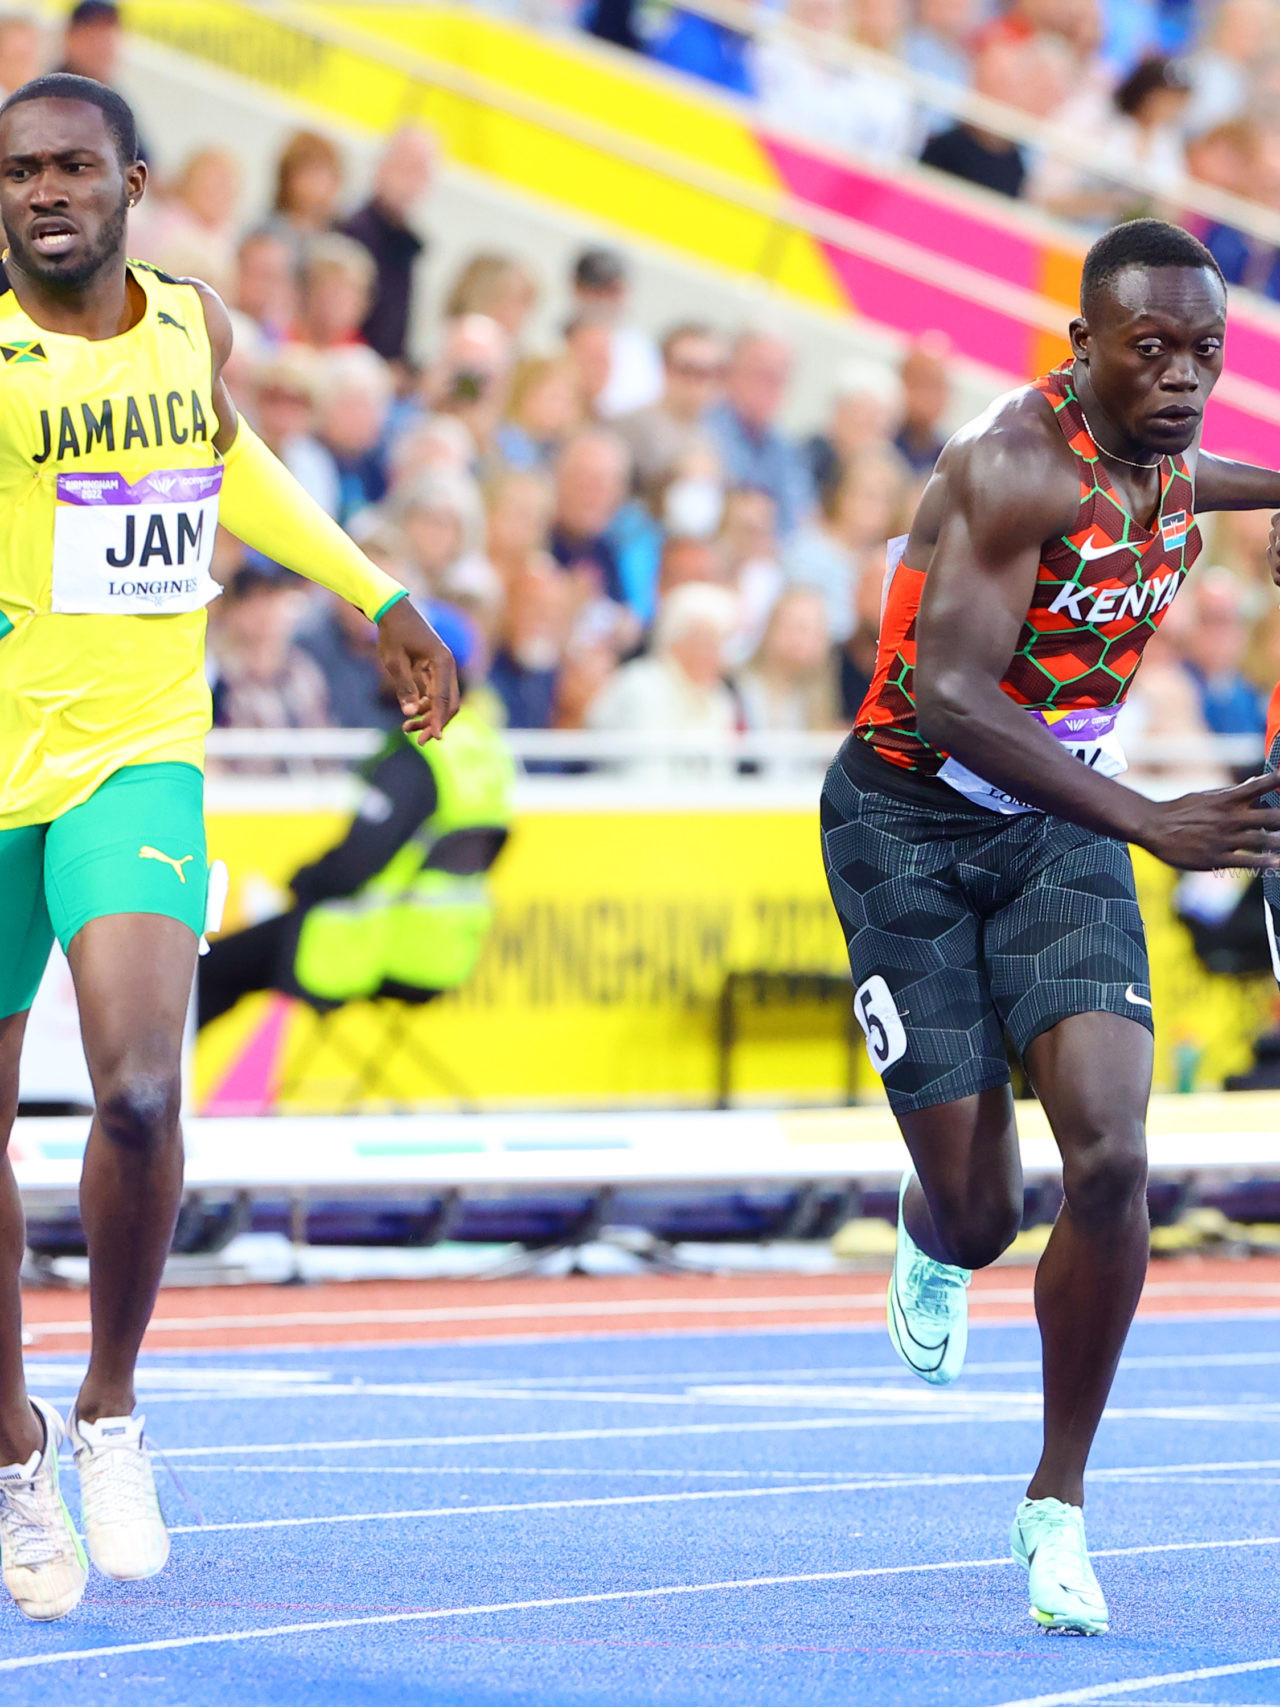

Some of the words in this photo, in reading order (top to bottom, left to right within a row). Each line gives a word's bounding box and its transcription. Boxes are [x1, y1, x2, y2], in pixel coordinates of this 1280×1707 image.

[32, 389, 208, 464] JAMAICA
[106, 510, 204, 568] JAM
[1047, 570, 1182, 623] KENYA
[860, 989, 890, 1062] 5
